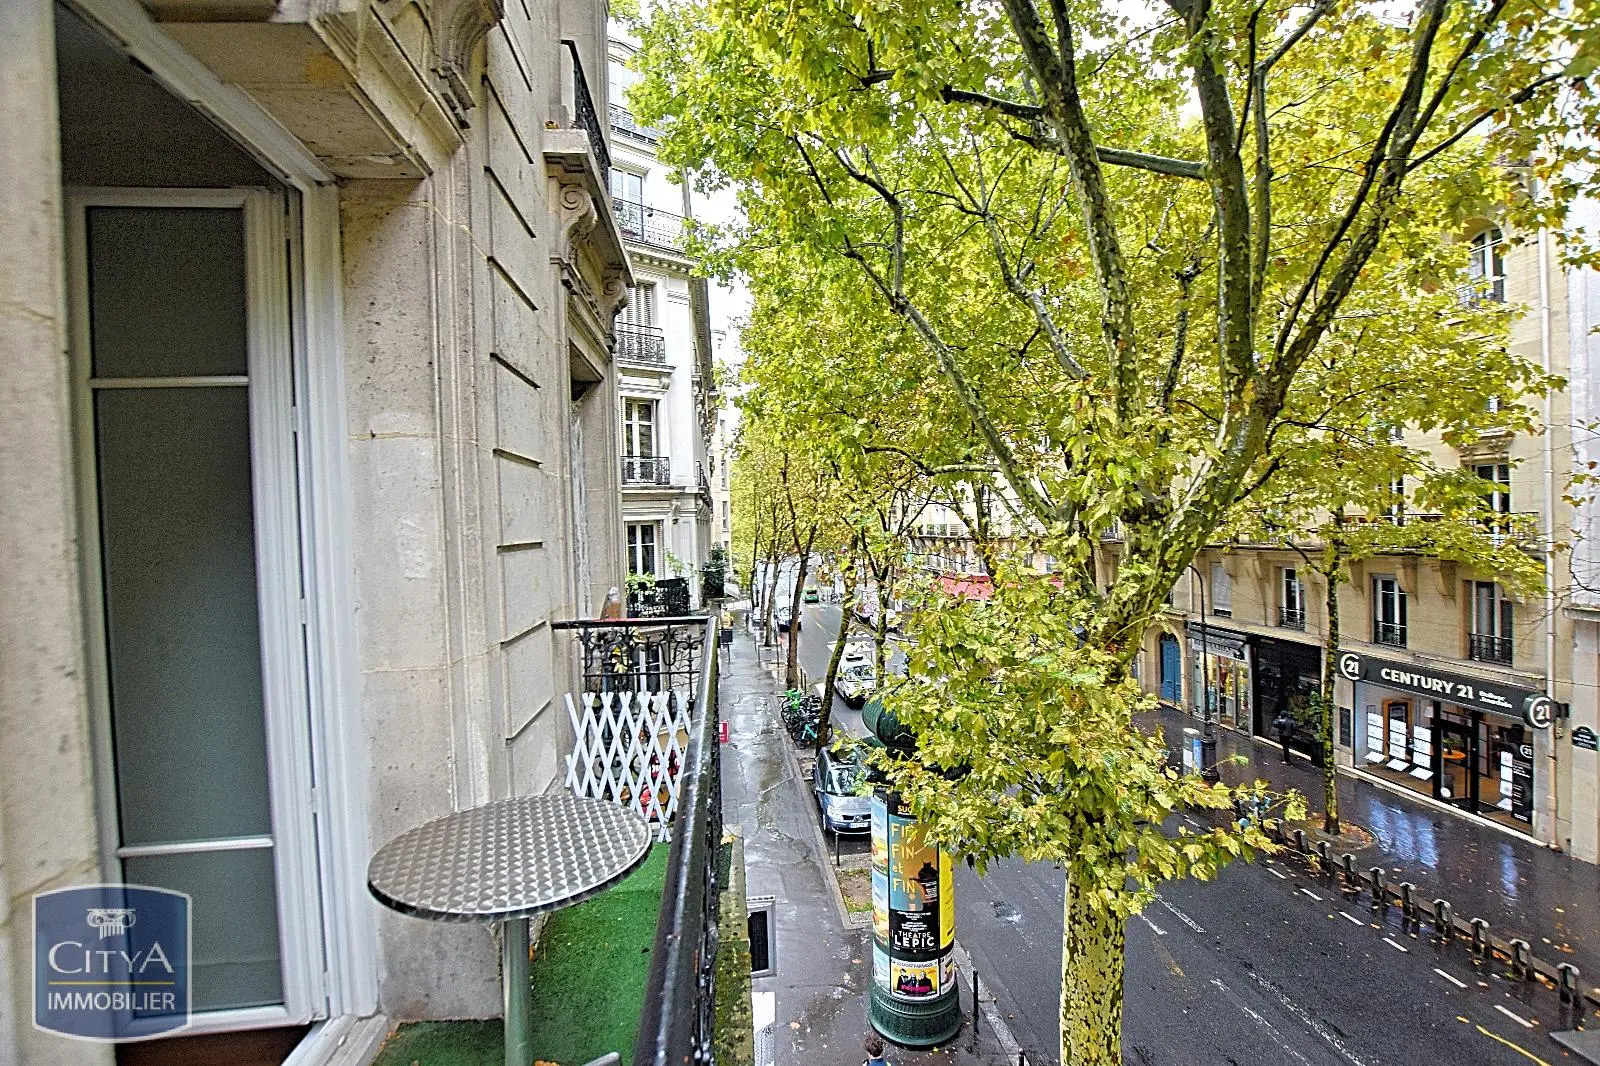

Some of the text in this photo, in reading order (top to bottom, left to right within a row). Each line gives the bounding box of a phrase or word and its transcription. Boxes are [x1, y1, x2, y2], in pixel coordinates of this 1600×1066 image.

[1381, 667, 1474, 699] CENTURY 21
[891, 843, 915, 860] FIN
[892, 862, 904, 875] et
[893, 877, 916, 894] FIN
[894, 934, 935, 949] LEPIC
